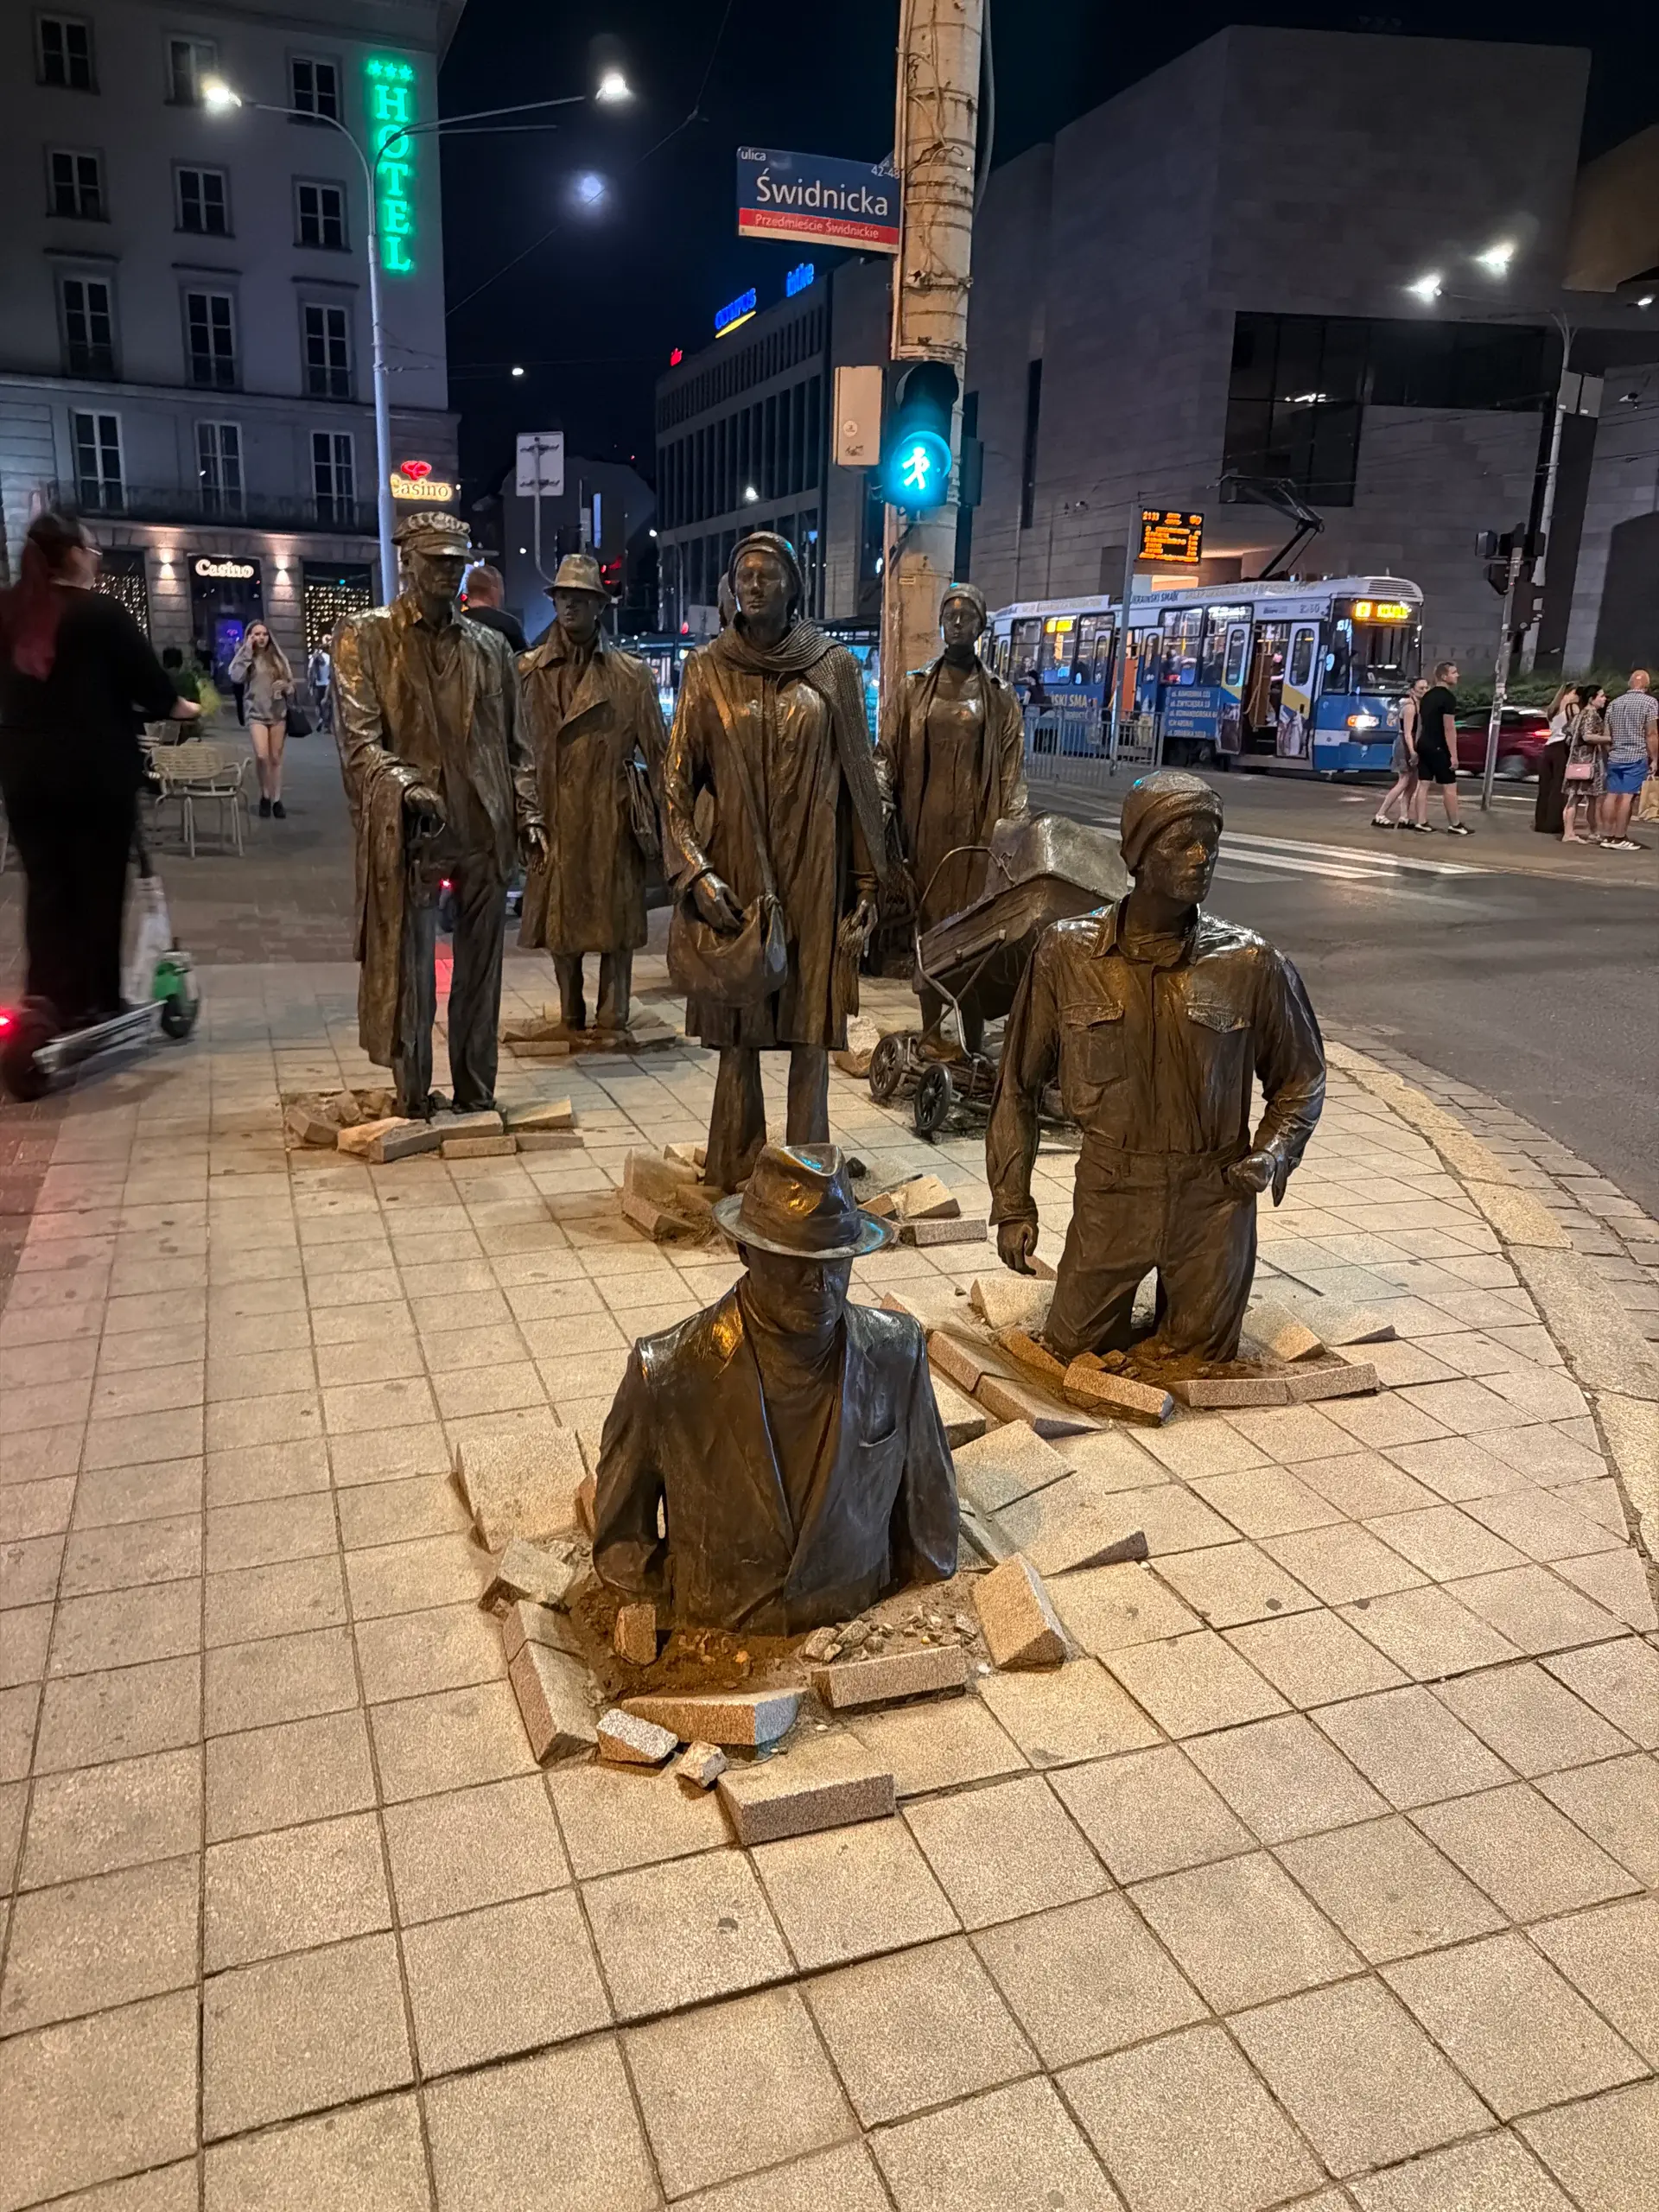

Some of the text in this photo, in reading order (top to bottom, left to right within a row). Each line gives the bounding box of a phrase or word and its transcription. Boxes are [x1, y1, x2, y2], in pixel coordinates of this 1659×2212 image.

[741, 149, 766, 162] ulica
[375, 84, 411, 272] HOTEL
[871, 164, 900, 180] 42-48
[756, 168, 888, 216] Świdnicka
[755, 213, 879, 238] Przedmieście Świdnickie
[195, 559, 254, 578] Casino
